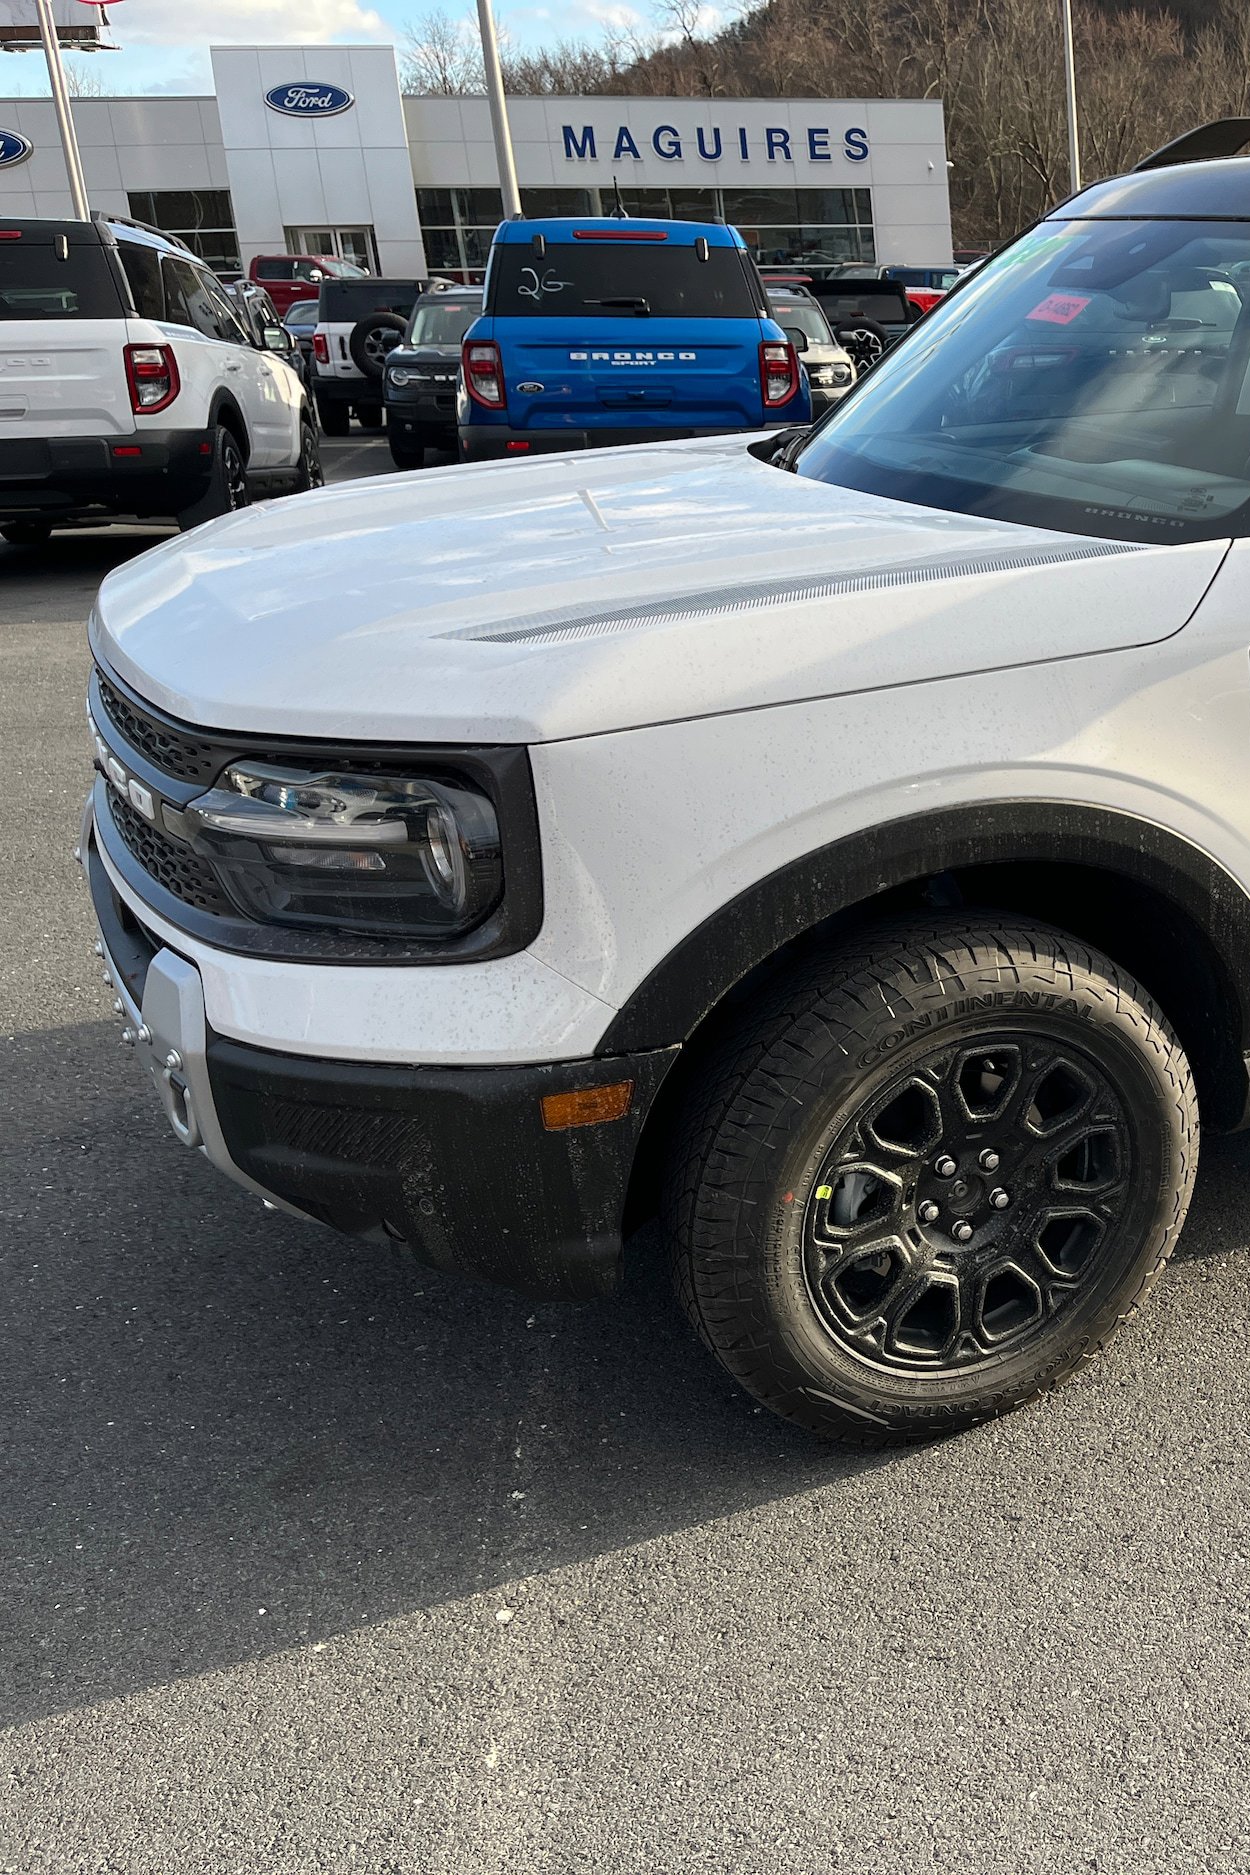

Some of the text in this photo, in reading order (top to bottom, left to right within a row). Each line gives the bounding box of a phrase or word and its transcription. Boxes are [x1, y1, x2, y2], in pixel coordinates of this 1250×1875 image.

[283, 87, 333, 108] Ford
[561, 124, 871, 162] MAGUIRES
[569, 352, 697, 361] BRONCO
[1084, 507, 1185, 528] BRONCO
[855, 989, 1098, 1070] CONTINENTAL
